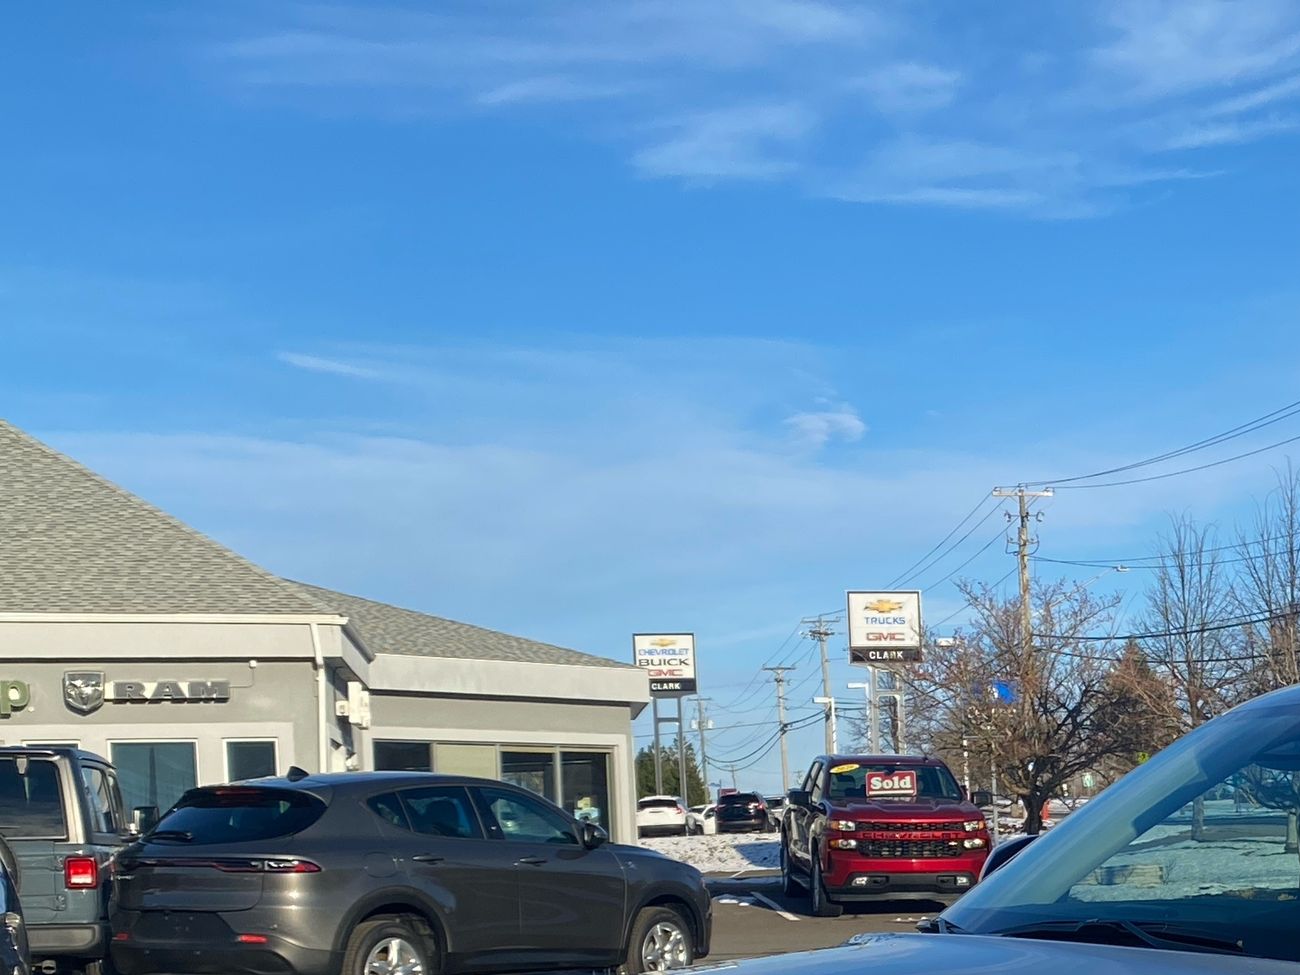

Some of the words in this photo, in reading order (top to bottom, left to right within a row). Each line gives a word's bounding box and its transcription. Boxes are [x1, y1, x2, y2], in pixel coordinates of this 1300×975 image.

[864, 616, 906, 625] TRUCKS
[866, 632, 905, 641] GMC
[638, 648, 689, 656] CHEVROLET
[869, 651, 903, 660] CLARK
[638, 658, 690, 667] BUICK
[648, 669, 683, 677] GMC
[113, 680, 230, 700] RAM
[651, 682, 681, 690] CLARK
[870, 775, 912, 790] Sold
